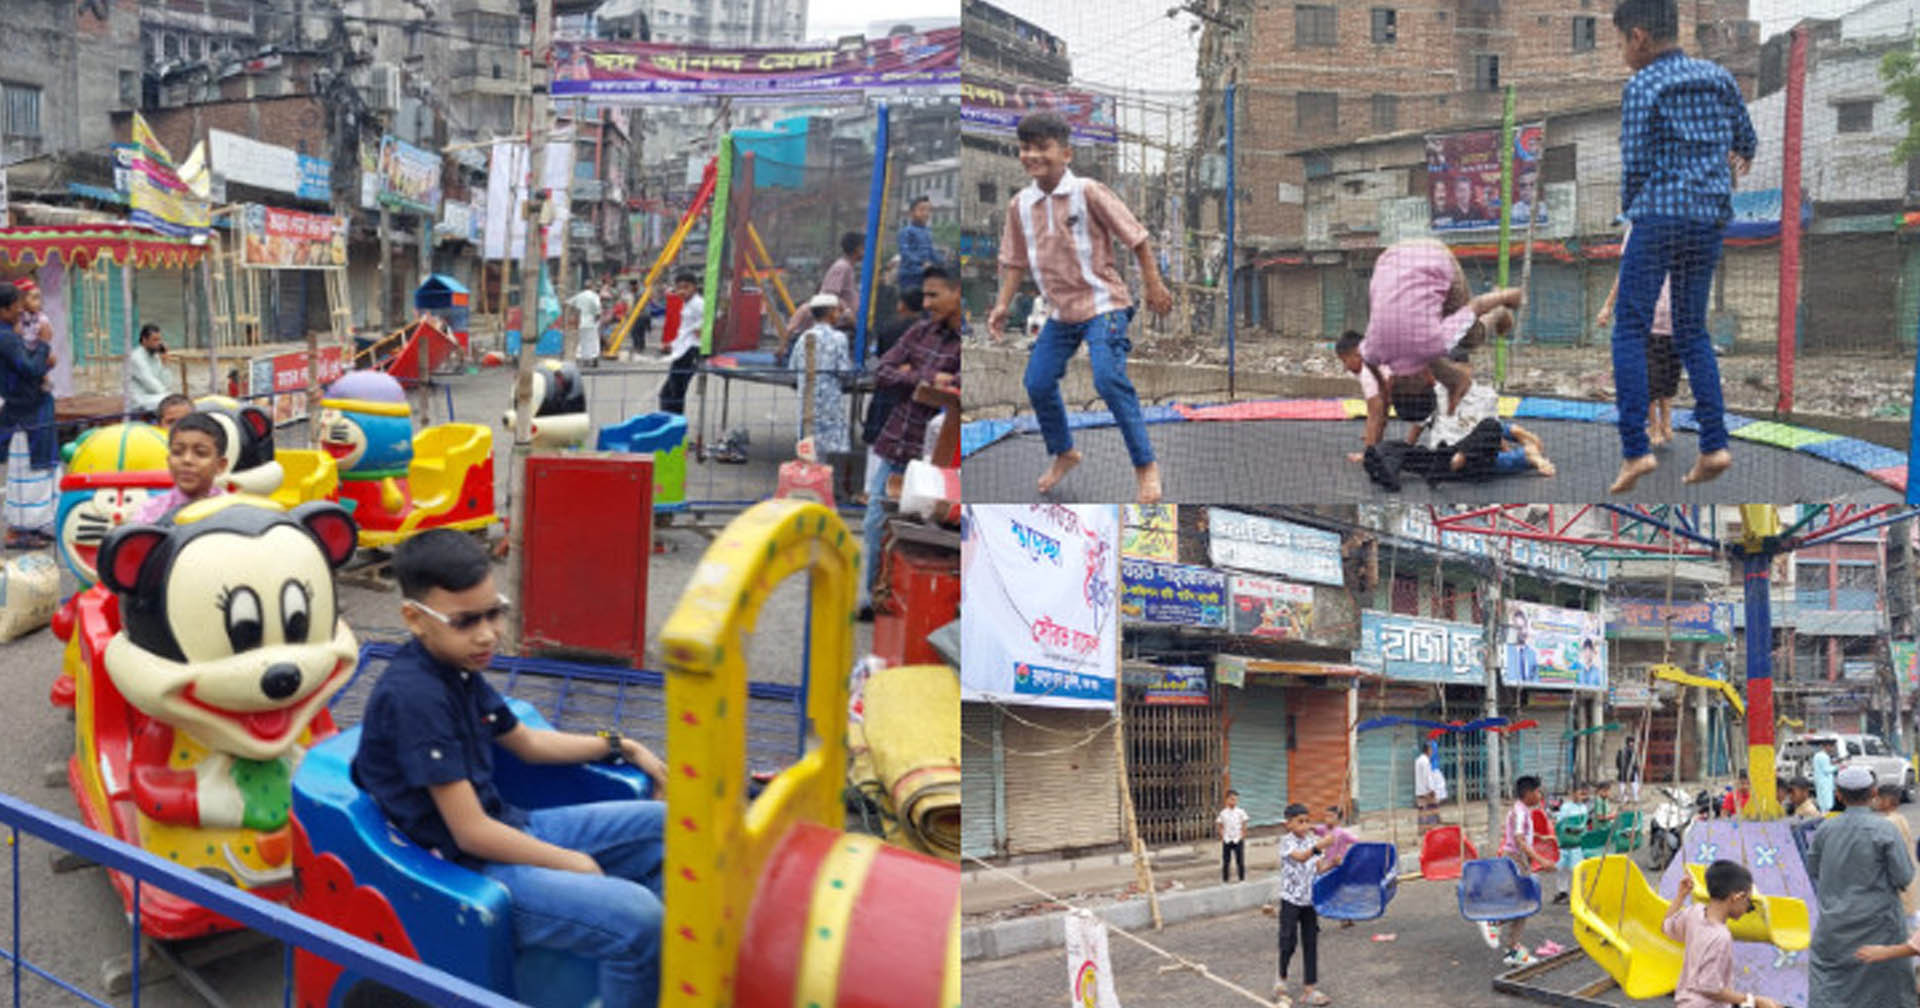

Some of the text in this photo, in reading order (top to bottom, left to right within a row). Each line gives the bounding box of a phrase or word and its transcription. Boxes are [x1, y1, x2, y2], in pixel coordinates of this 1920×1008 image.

[650, 51, 745, 72] আনন্দ
[758, 50, 837, 71] মেলা
[1381, 620, 1449, 664] হাজী
